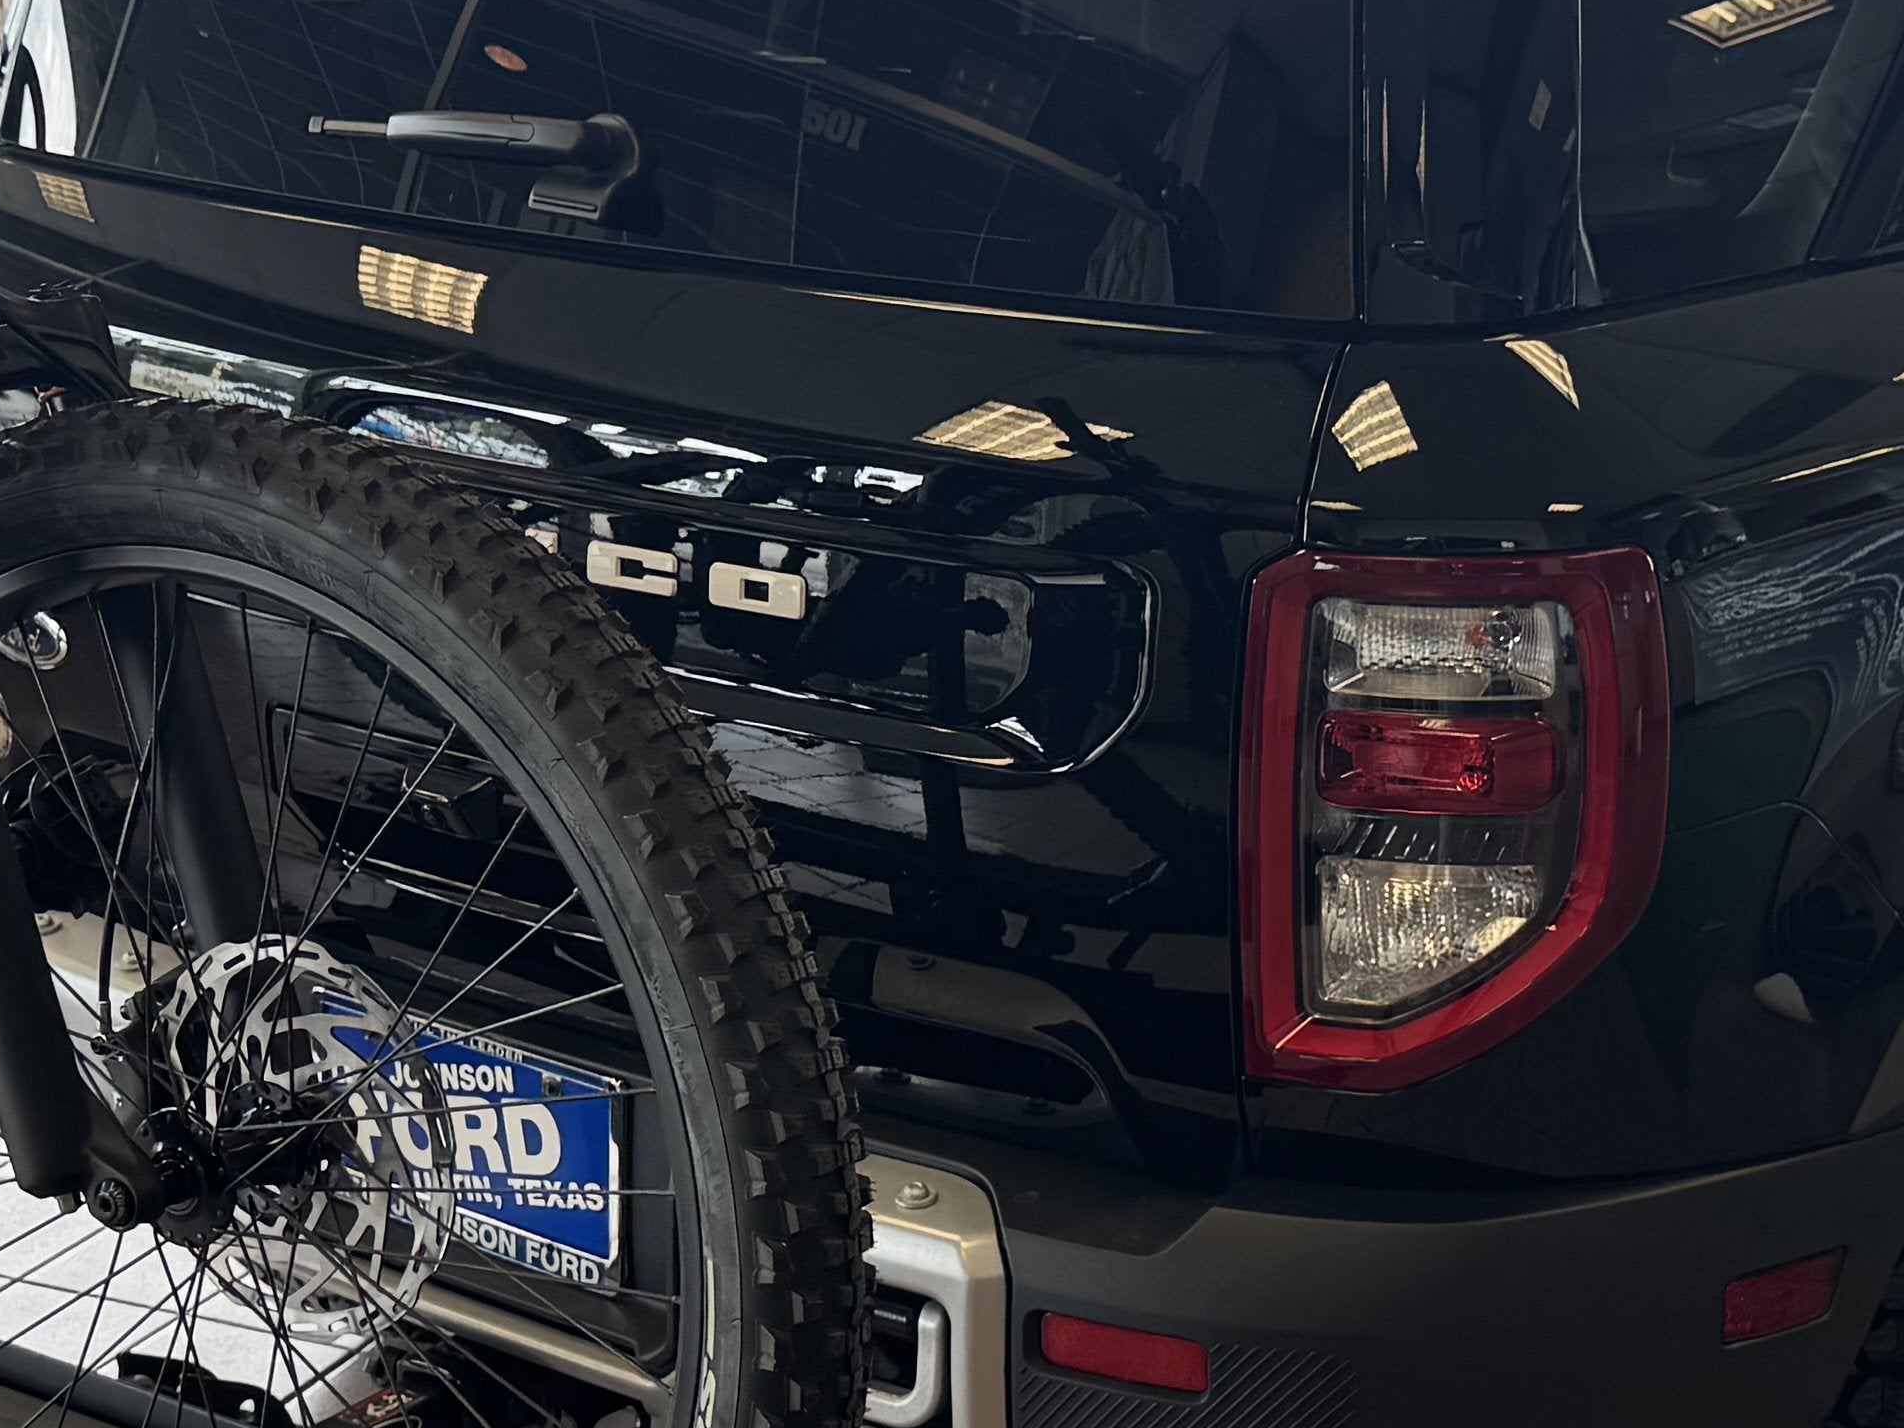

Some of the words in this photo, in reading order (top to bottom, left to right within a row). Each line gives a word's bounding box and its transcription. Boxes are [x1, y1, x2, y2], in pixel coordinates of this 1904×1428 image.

[389, 1060, 515, 1095] JONSON
[507, 1177, 606, 1212] TEXAS
[526, 1238, 601, 1285] FORD
